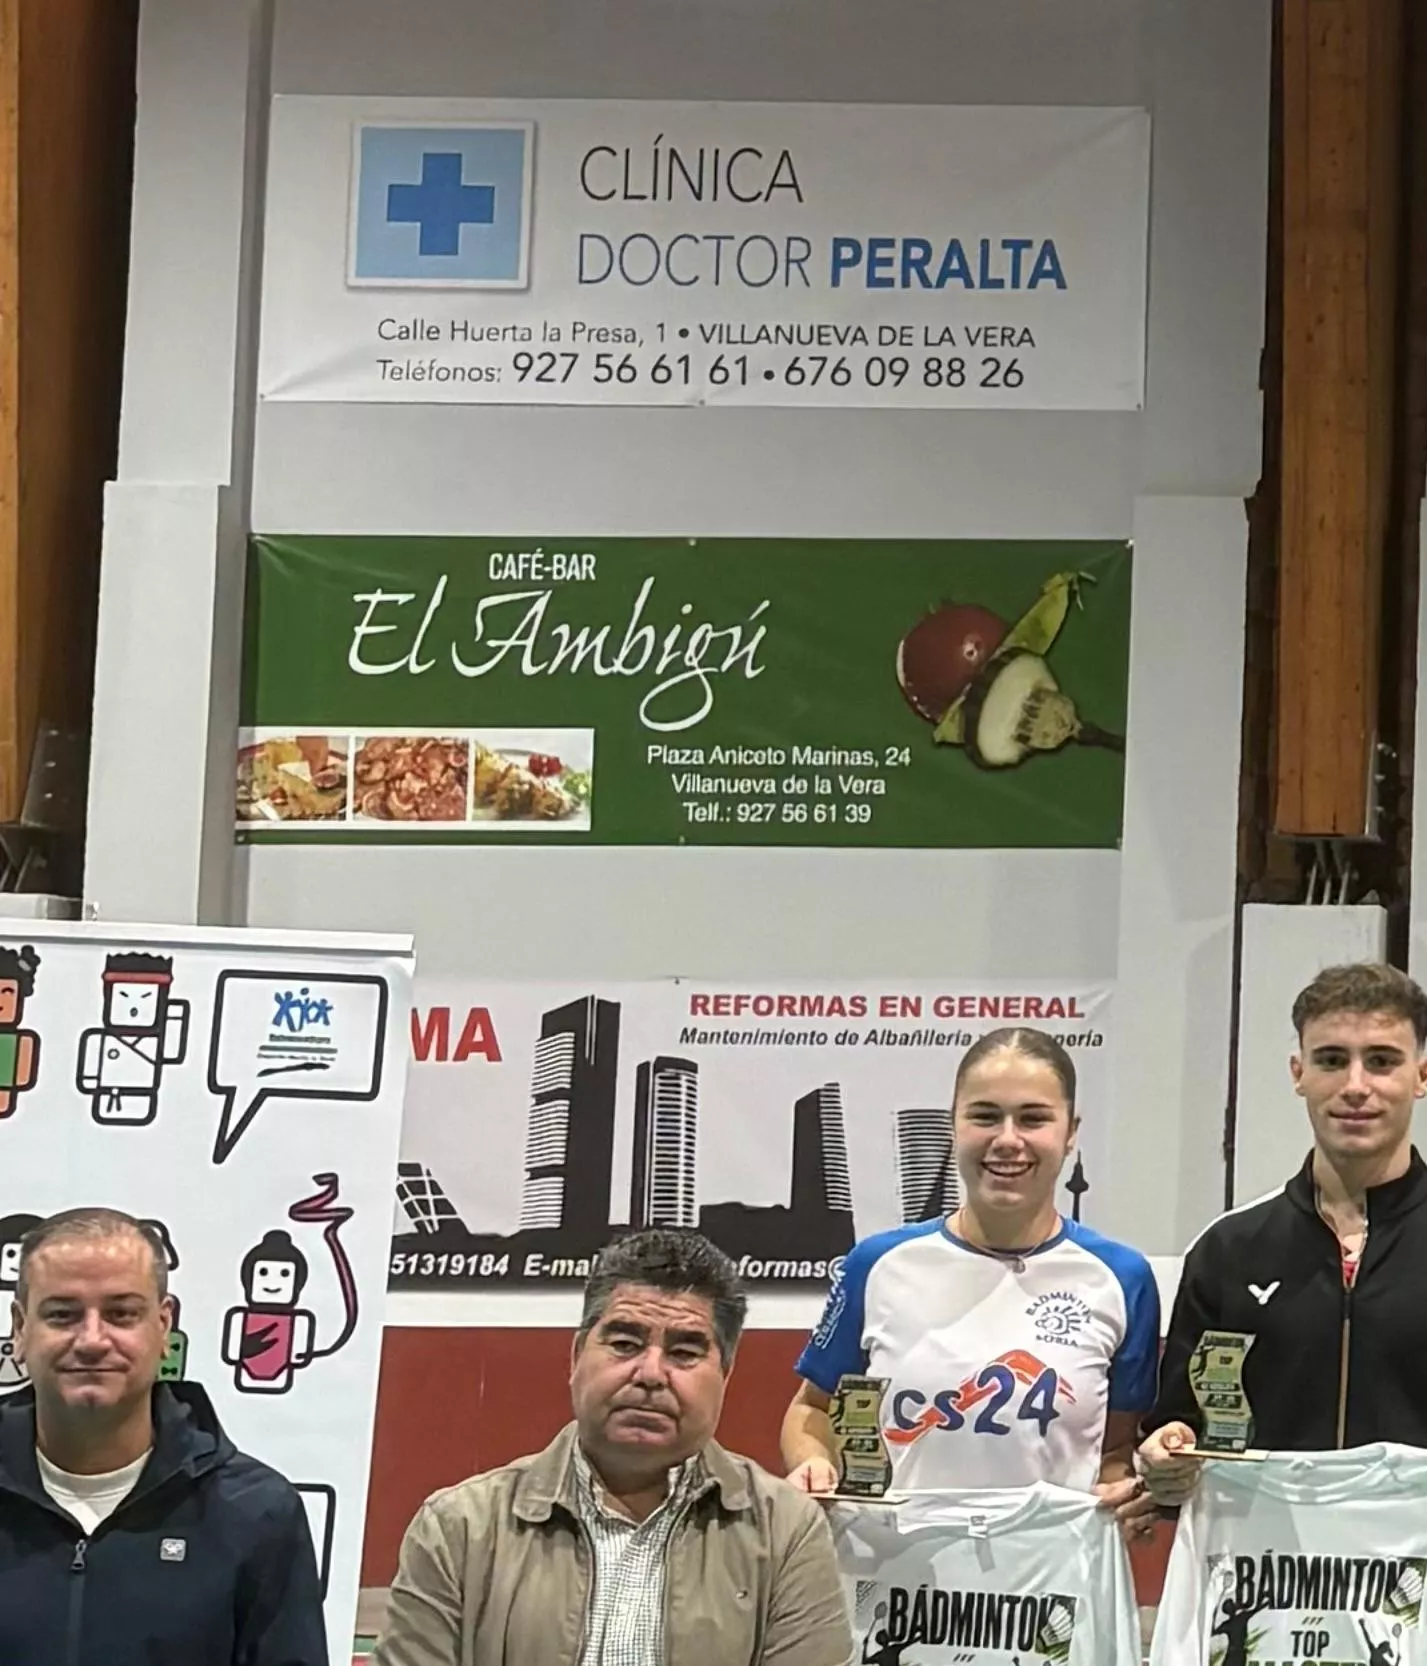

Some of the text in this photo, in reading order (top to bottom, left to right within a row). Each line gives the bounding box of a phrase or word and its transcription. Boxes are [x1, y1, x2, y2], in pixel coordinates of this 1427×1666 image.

[578, 134, 804, 204] CLÍNICA
[576, 232, 1068, 291] DOCTOR PERALTA
[377, 318, 1035, 348] Calle Huerta la Presa, 1 VILLANUEVA DE LA VERA
[377, 352, 1024, 387] Teléfonos: 927 56 61 61 676 09 88 26
[488, 549, 596, 582] CAFÉ-BAR
[347, 573, 771, 733] El Ambigú
[648, 745, 911, 767] Plaza Aniceto Marinas, 24
[672, 773, 885, 795] Villanueva de la Vera
[683, 801, 871, 822] Telf.: 927 56 61 39
[690, 994, 1085, 1019] REFORMAS EN GENERAL
[679, 1027, 828, 1045] Mantenimiento
[834, 1030, 859, 1046] de
[864, 1029, 972, 1047] Albañilería
[390, 1255, 509, 1276] 51319184
[1291, 1630, 1330, 1657] TOP
